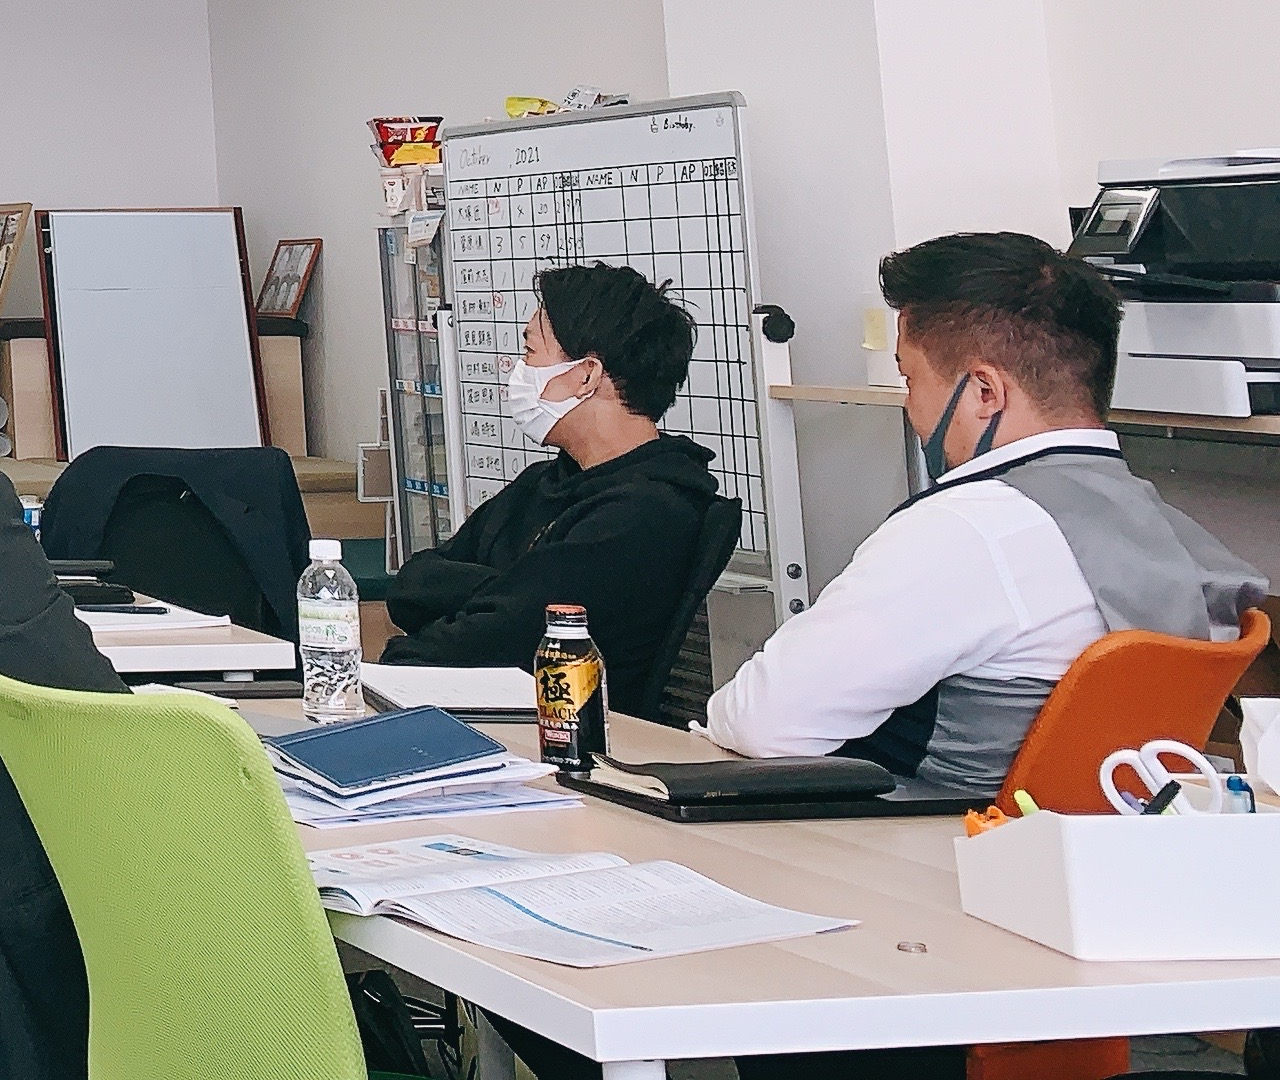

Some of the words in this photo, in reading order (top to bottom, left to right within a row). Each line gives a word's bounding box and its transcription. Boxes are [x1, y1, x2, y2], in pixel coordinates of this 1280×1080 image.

[585, 172, 613, 186] NAME
[630, 169, 639, 183] N
[656, 165, 664, 182] P
[680, 163, 696, 181] AP
[493, 181, 502, 193] N
[517, 178, 524, 193] P
[536, 176, 548, 191] AP
[495, 236, 504, 254] 3
[539, 669, 575, 705] 極
